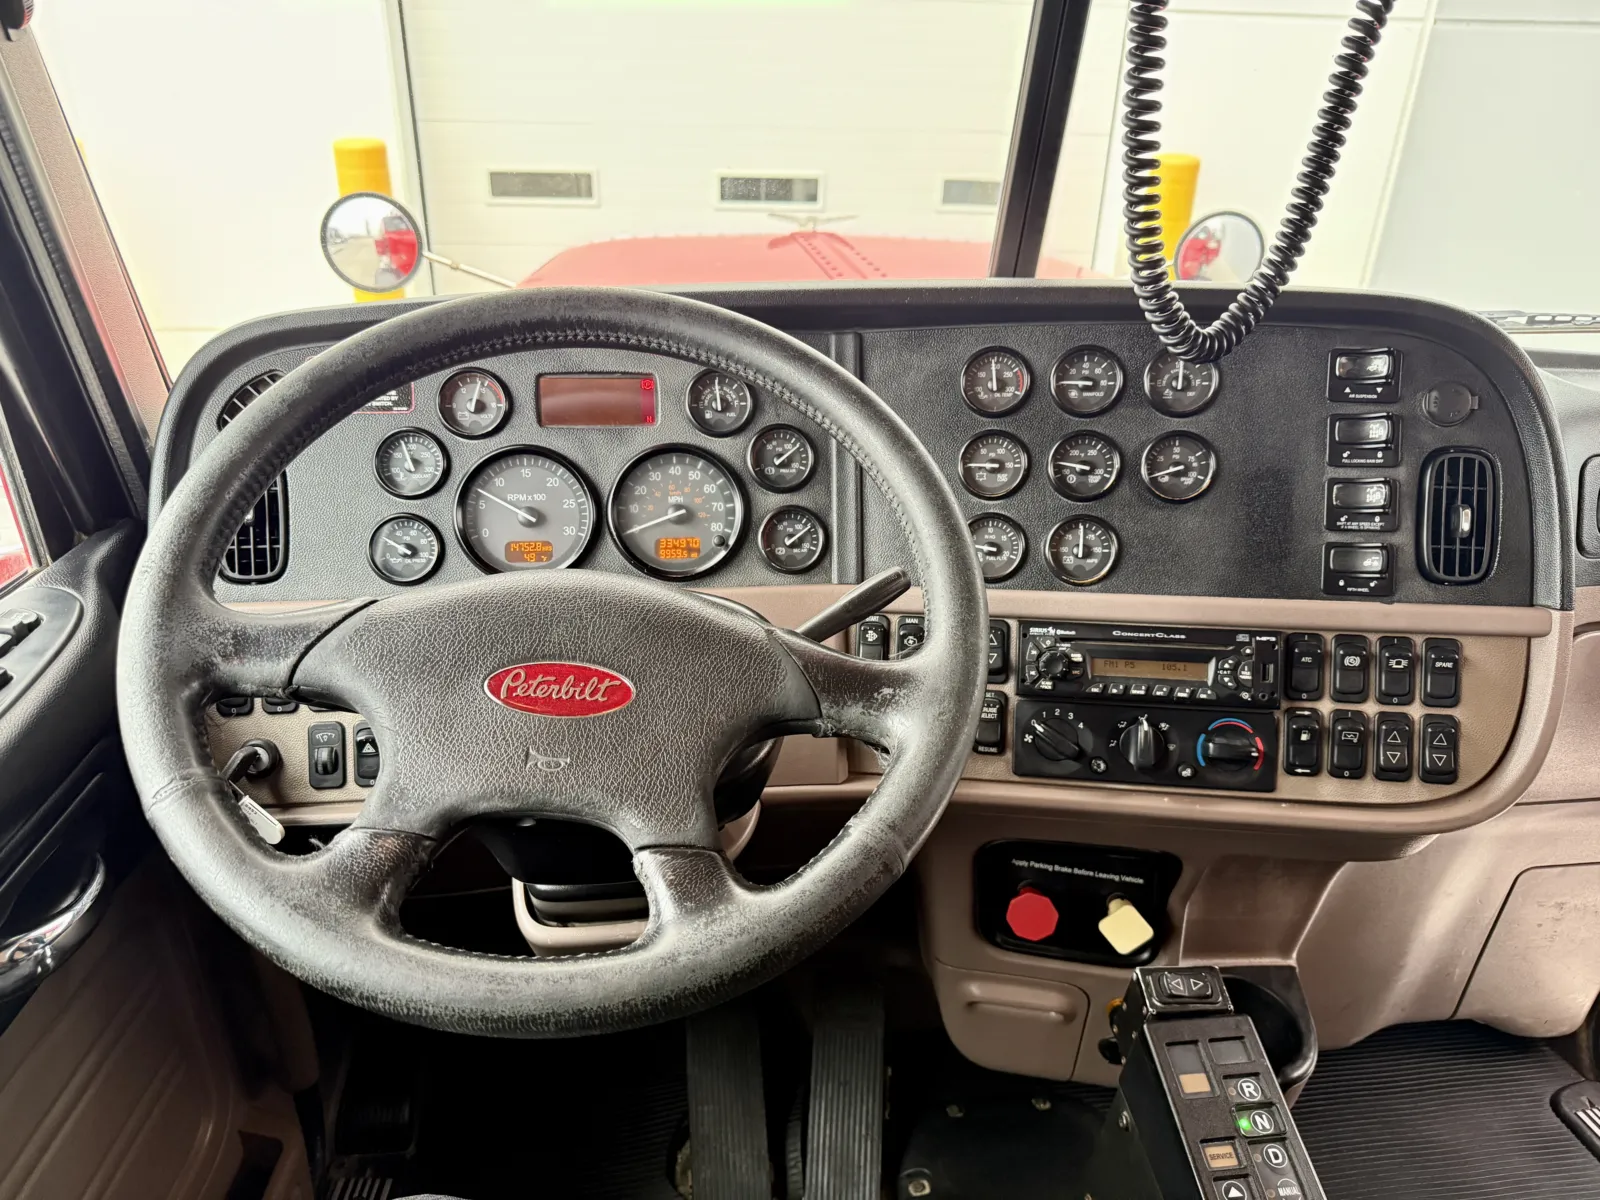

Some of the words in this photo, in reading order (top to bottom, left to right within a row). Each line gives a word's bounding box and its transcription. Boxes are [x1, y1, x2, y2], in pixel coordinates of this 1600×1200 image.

[1081, 361, 1090, 369] 40
[1094, 367, 1102, 375] 60
[520, 468, 532, 478] 15
[668, 465, 682, 475] 40
[688, 470, 701, 480] 50
[648, 471, 662, 481] 30
[494, 477, 505, 487] 10
[546, 477, 559, 487] 20
[634, 485, 647, 495] 20
[703, 483, 716, 493] 60
[479, 500, 486, 509] 5
[563, 498, 576, 509] 25
[629, 503, 639, 513] 10
[711, 502, 724, 511] 70
[563, 526, 576, 536] 30
[710, 522, 723, 532] 80
[482, 527, 489, 538] 0
[524, 553, 536, 562] 49
[1162, 664, 1188, 672] 105.1
[1434, 661, 1454, 669] SPARE
[500, 668, 622, 701] Peterbilt
[1054, 708, 1061, 716] 2
[1067, 712, 1074, 720] 3
[1078, 721, 1084, 729] 4
[977, 745, 998, 753] RESUME
[1011, 858, 1029, 867] Apply
[1029, 861, 1054, 872] Parking
[1054, 864, 1073, 874] Brake
[1073, 867, 1095, 877] Before
[1095, 870, 1120, 883] Leaving
[1120, 874, 1144, 884] Vehicle
[1241, 1081, 1258, 1097] R
[1254, 1113, 1270, 1129] N
[1208, 1151, 1235, 1161] SERVICE
[1267, 1148, 1283, 1164] D
[1277, 1185, 1300, 1197] MANUAL
